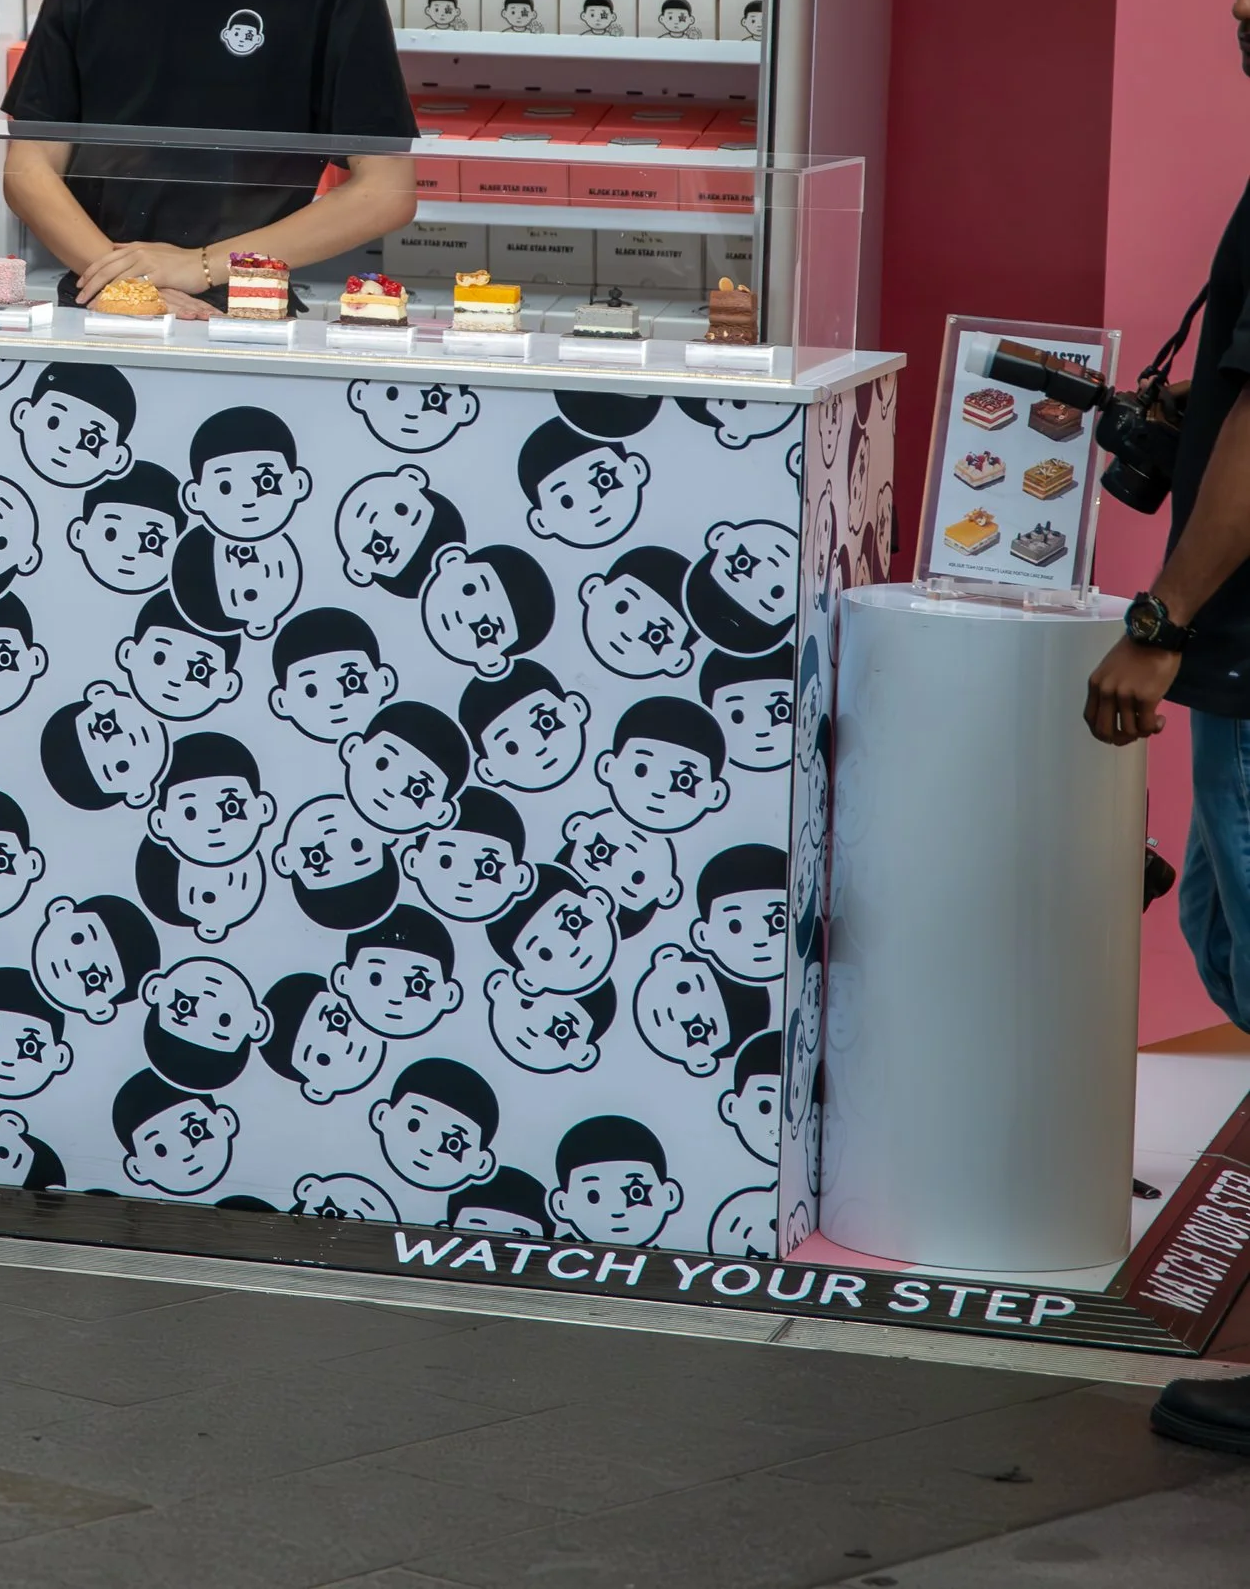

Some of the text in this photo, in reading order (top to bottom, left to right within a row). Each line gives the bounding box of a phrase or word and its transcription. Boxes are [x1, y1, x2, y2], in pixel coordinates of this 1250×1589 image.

[479, 183, 500, 192] BLACK
[522, 185, 548, 193] PASTRY
[588, 188, 657, 199] BLACK STAR PASTRY
[401, 238, 422, 246] BLACK
[442, 240, 468, 249] PASTRY
[507, 243, 528, 251] BLACK
[548, 245, 574, 253] PASTRY
[615, 247, 682, 258] BLACK STAR PASTRY
[1176, 1205, 1250, 1258] YOUR
[394, 1232, 1076, 1326] WATCH YOUR STEP
[1139, 1243, 1231, 1314] WATCH
